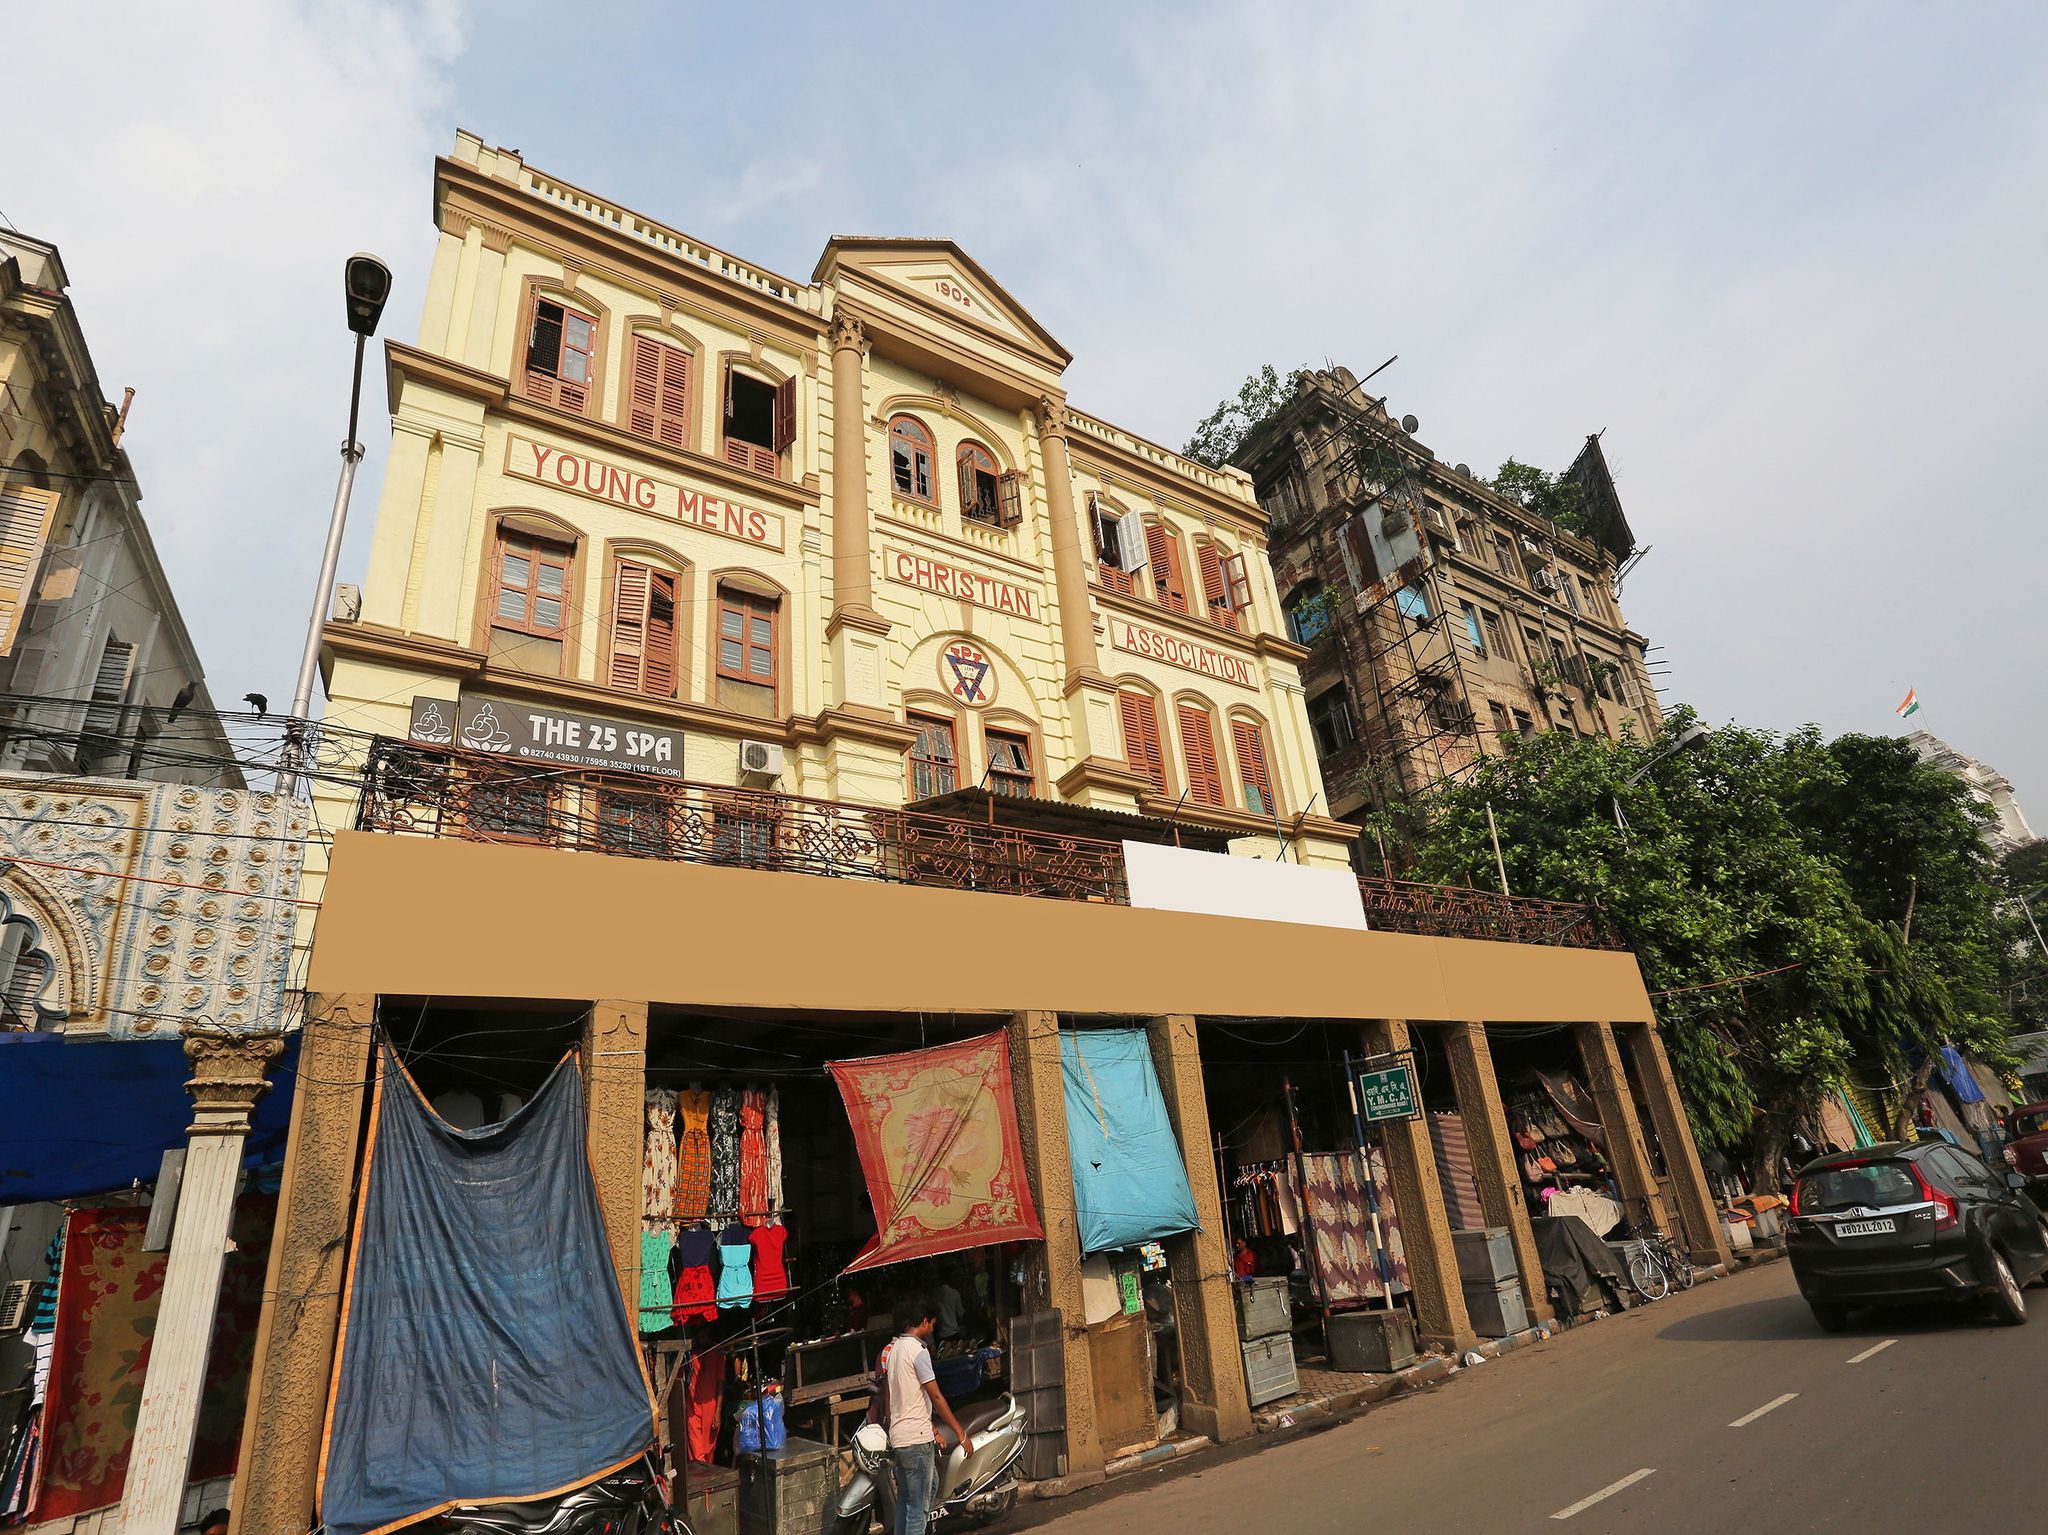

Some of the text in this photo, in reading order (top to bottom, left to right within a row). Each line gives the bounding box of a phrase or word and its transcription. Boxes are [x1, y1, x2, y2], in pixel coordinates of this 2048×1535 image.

[531, 443, 767, 541] YOUNG MENS
[896, 552, 1031, 617] CHRISTIAN
[1126, 624, 1249, 685] ASSOCIATION
[528, 714, 672, 763] THE 25 SPA
[530, 749, 554, 759] 82740
[556, 752, 579, 763] 43930
[585, 756, 608, 767] 75958
[609, 760, 632, 770] 35280
[633, 763, 650, 773] (1ST
[652, 766, 681, 778] FLOOR)
[1841, 1221, 1893, 1233] WB02AL2012
